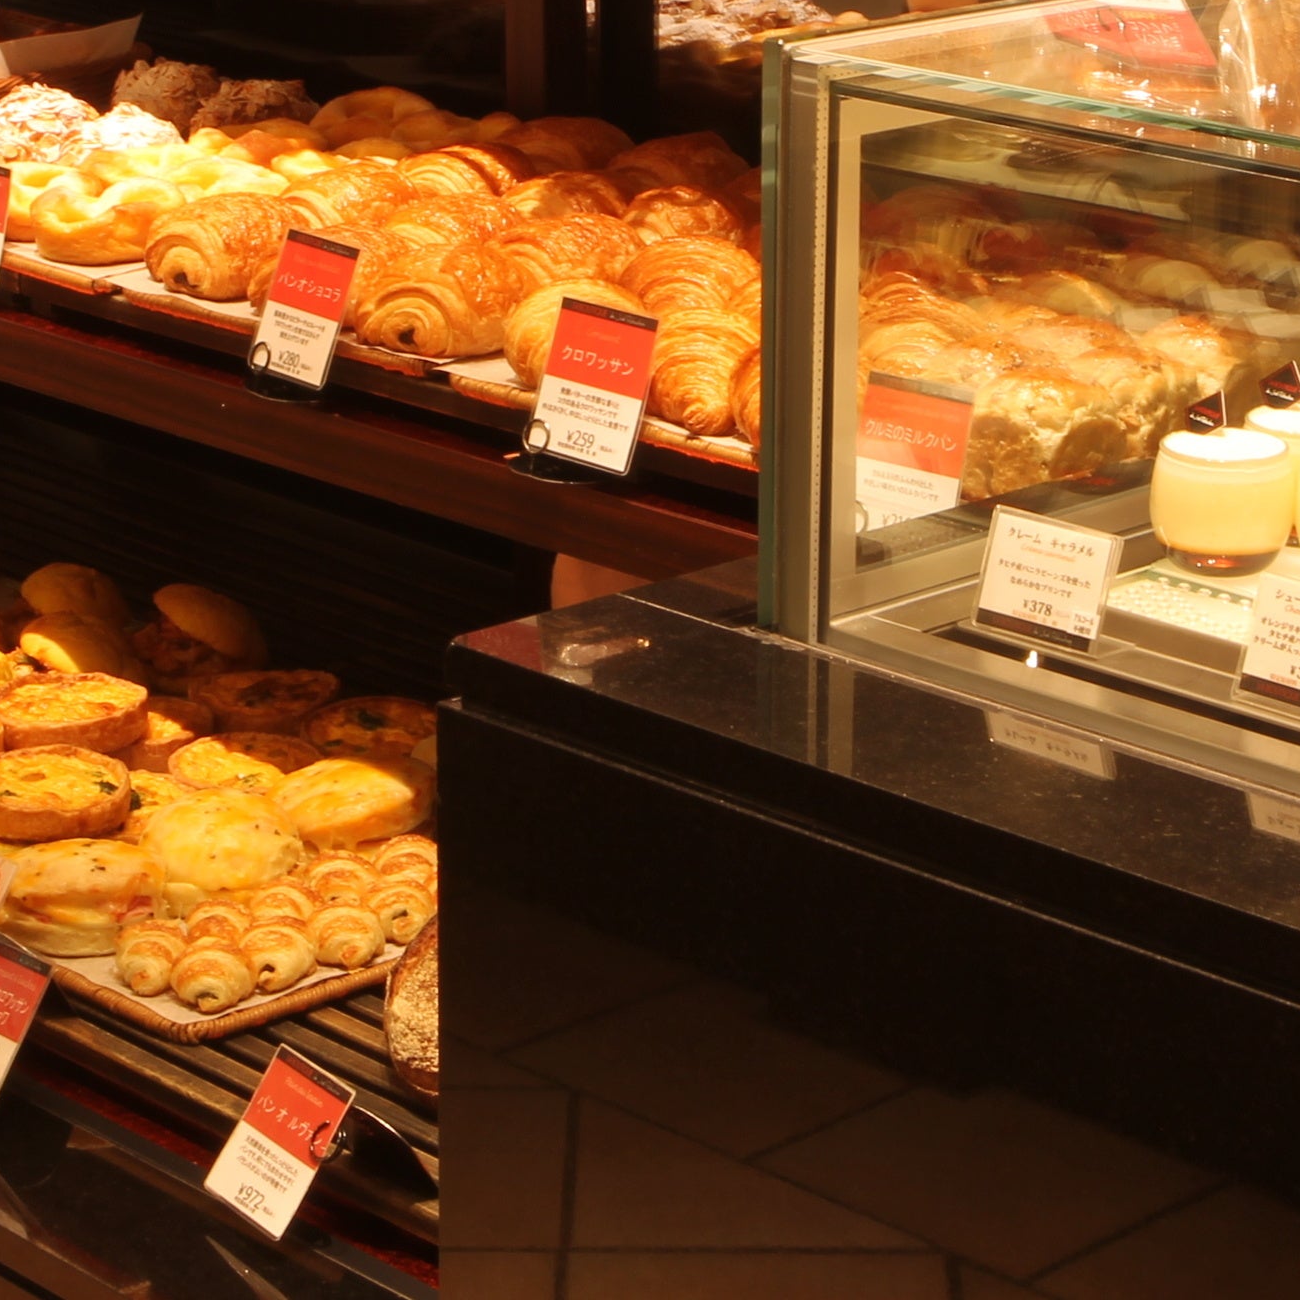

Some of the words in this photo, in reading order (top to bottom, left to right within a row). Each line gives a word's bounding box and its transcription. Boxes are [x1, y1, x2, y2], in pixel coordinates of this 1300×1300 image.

[278, 350, 300, 368] ¥280
[562, 345, 634, 376] クロワッサン
[567, 429, 595, 449] ¥259
[866, 419, 957, 452] クルミのミルクパン
[1009, 527, 1041, 544] クレーム
[1051, 538, 1094, 557] キャラメル
[1023, 599, 1052, 616] ¥378
[237, 1183, 265, 1210] ¥972
